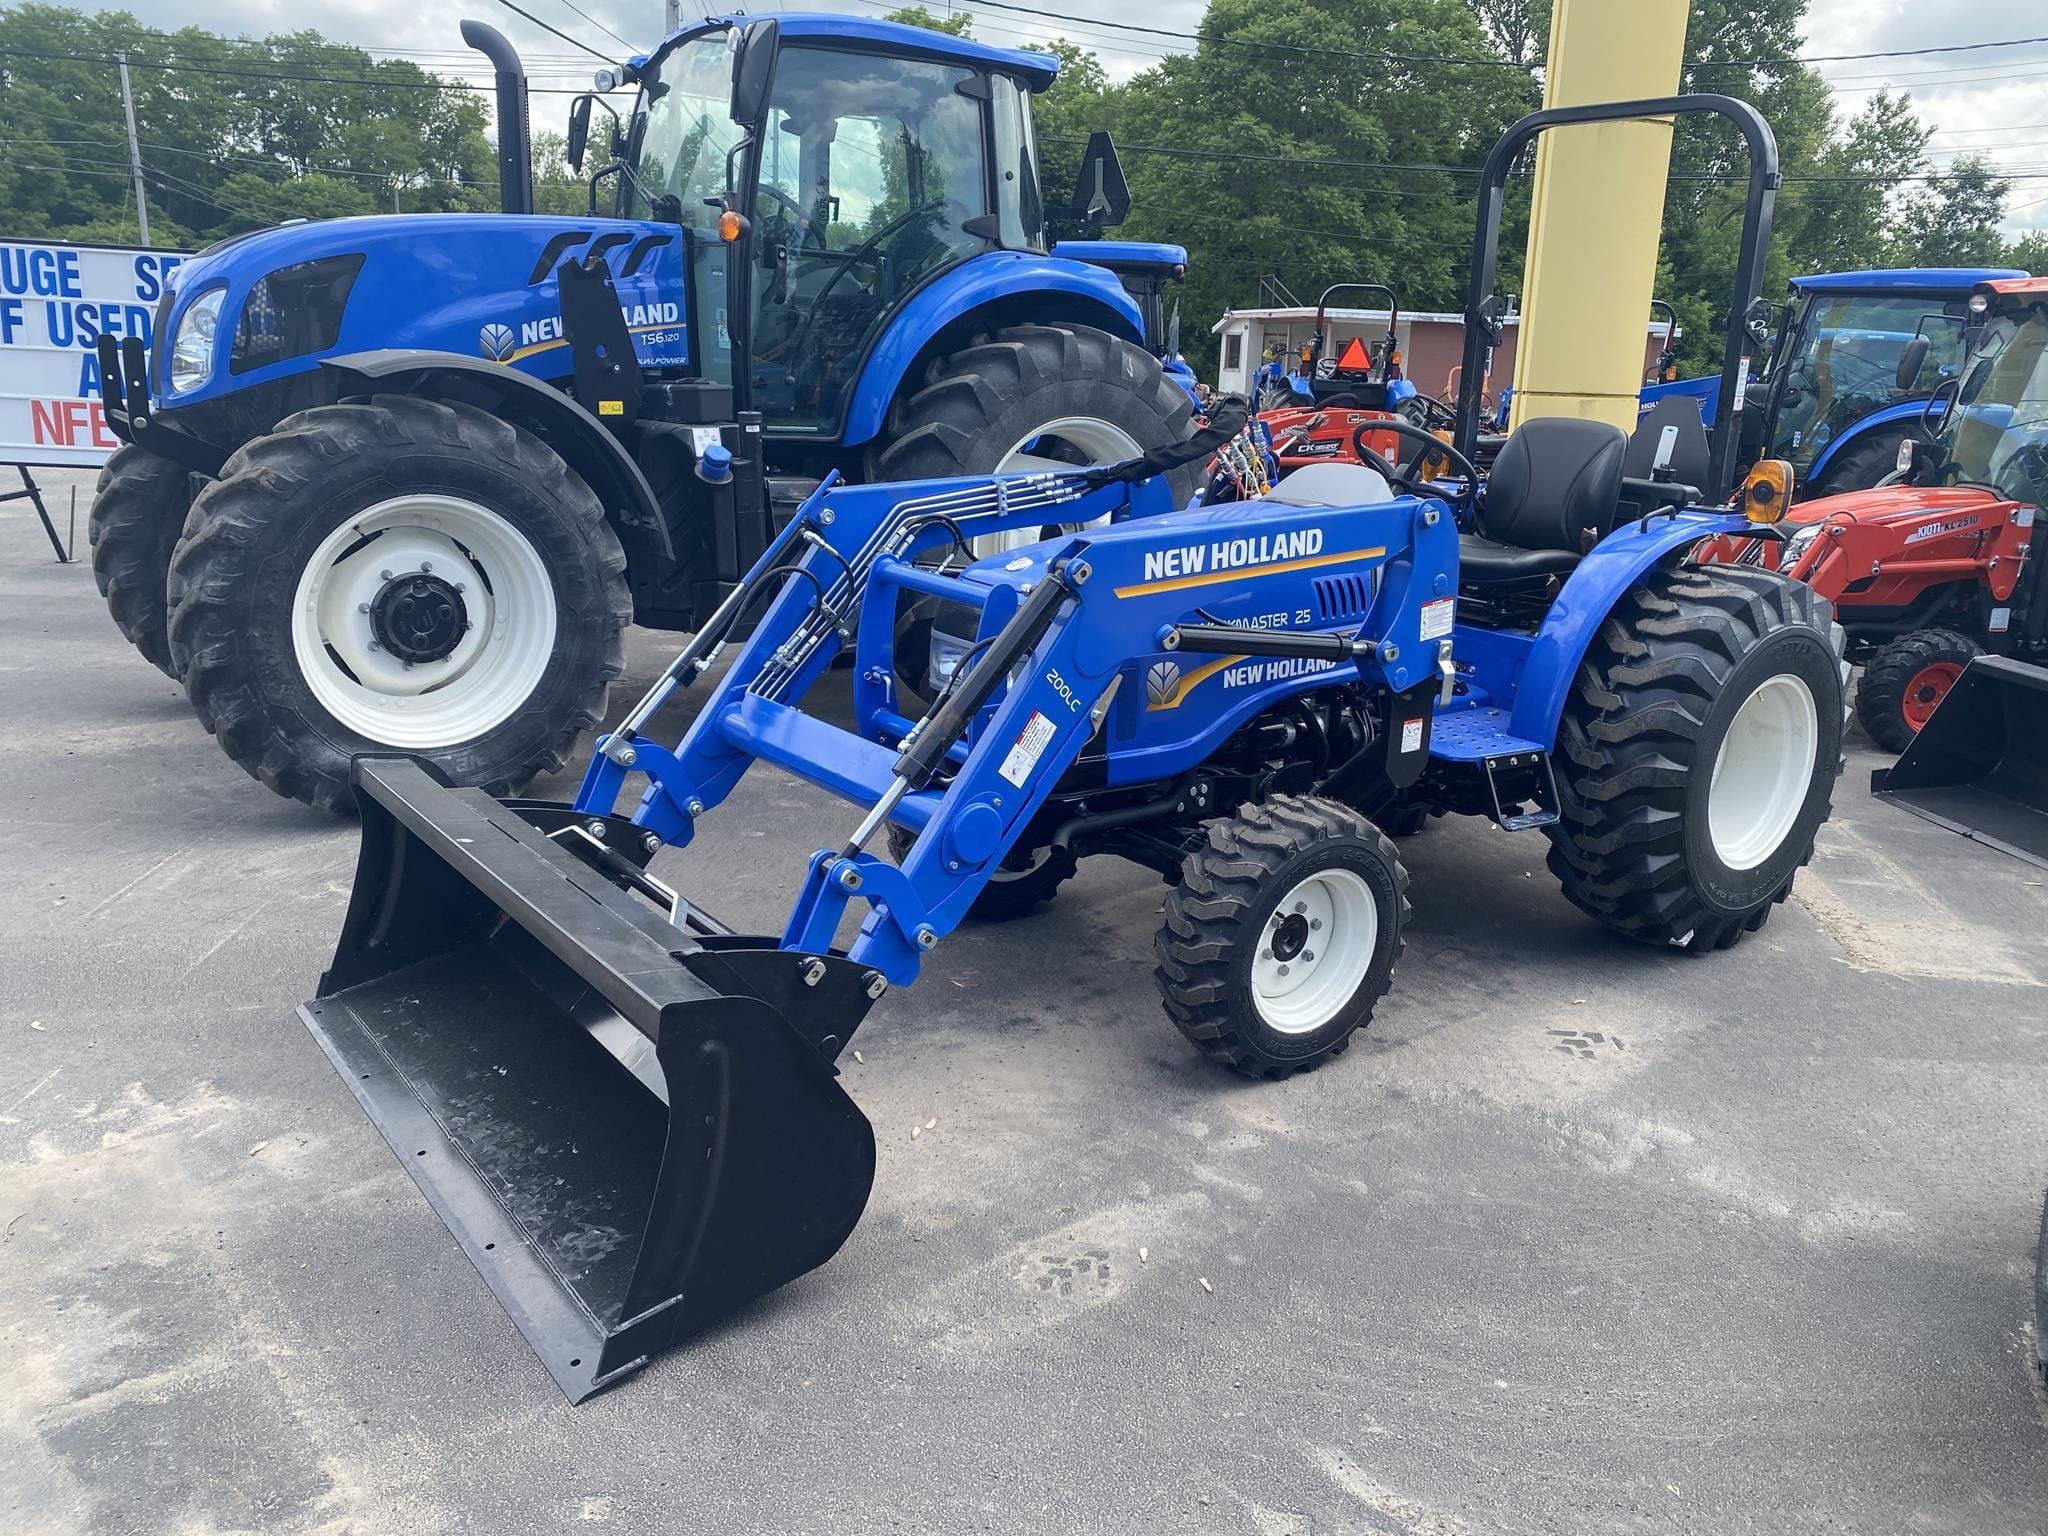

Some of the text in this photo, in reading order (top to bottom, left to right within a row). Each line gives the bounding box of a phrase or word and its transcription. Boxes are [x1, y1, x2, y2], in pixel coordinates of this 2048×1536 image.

[0, 248, 82, 298] UGE
[46, 301, 151, 350] USED
[621, 302, 678, 327] LAND
[31, 400, 118, 448] NFE
[1917, 522, 1940, 538] KIOTI
[1144, 528, 1323, 581] NEW HOLLAND
[1295, 609, 1311, 624] 25
[1046, 668, 1081, 712] 200LC
[1223, 658, 1336, 688] NEW HOLLAND
